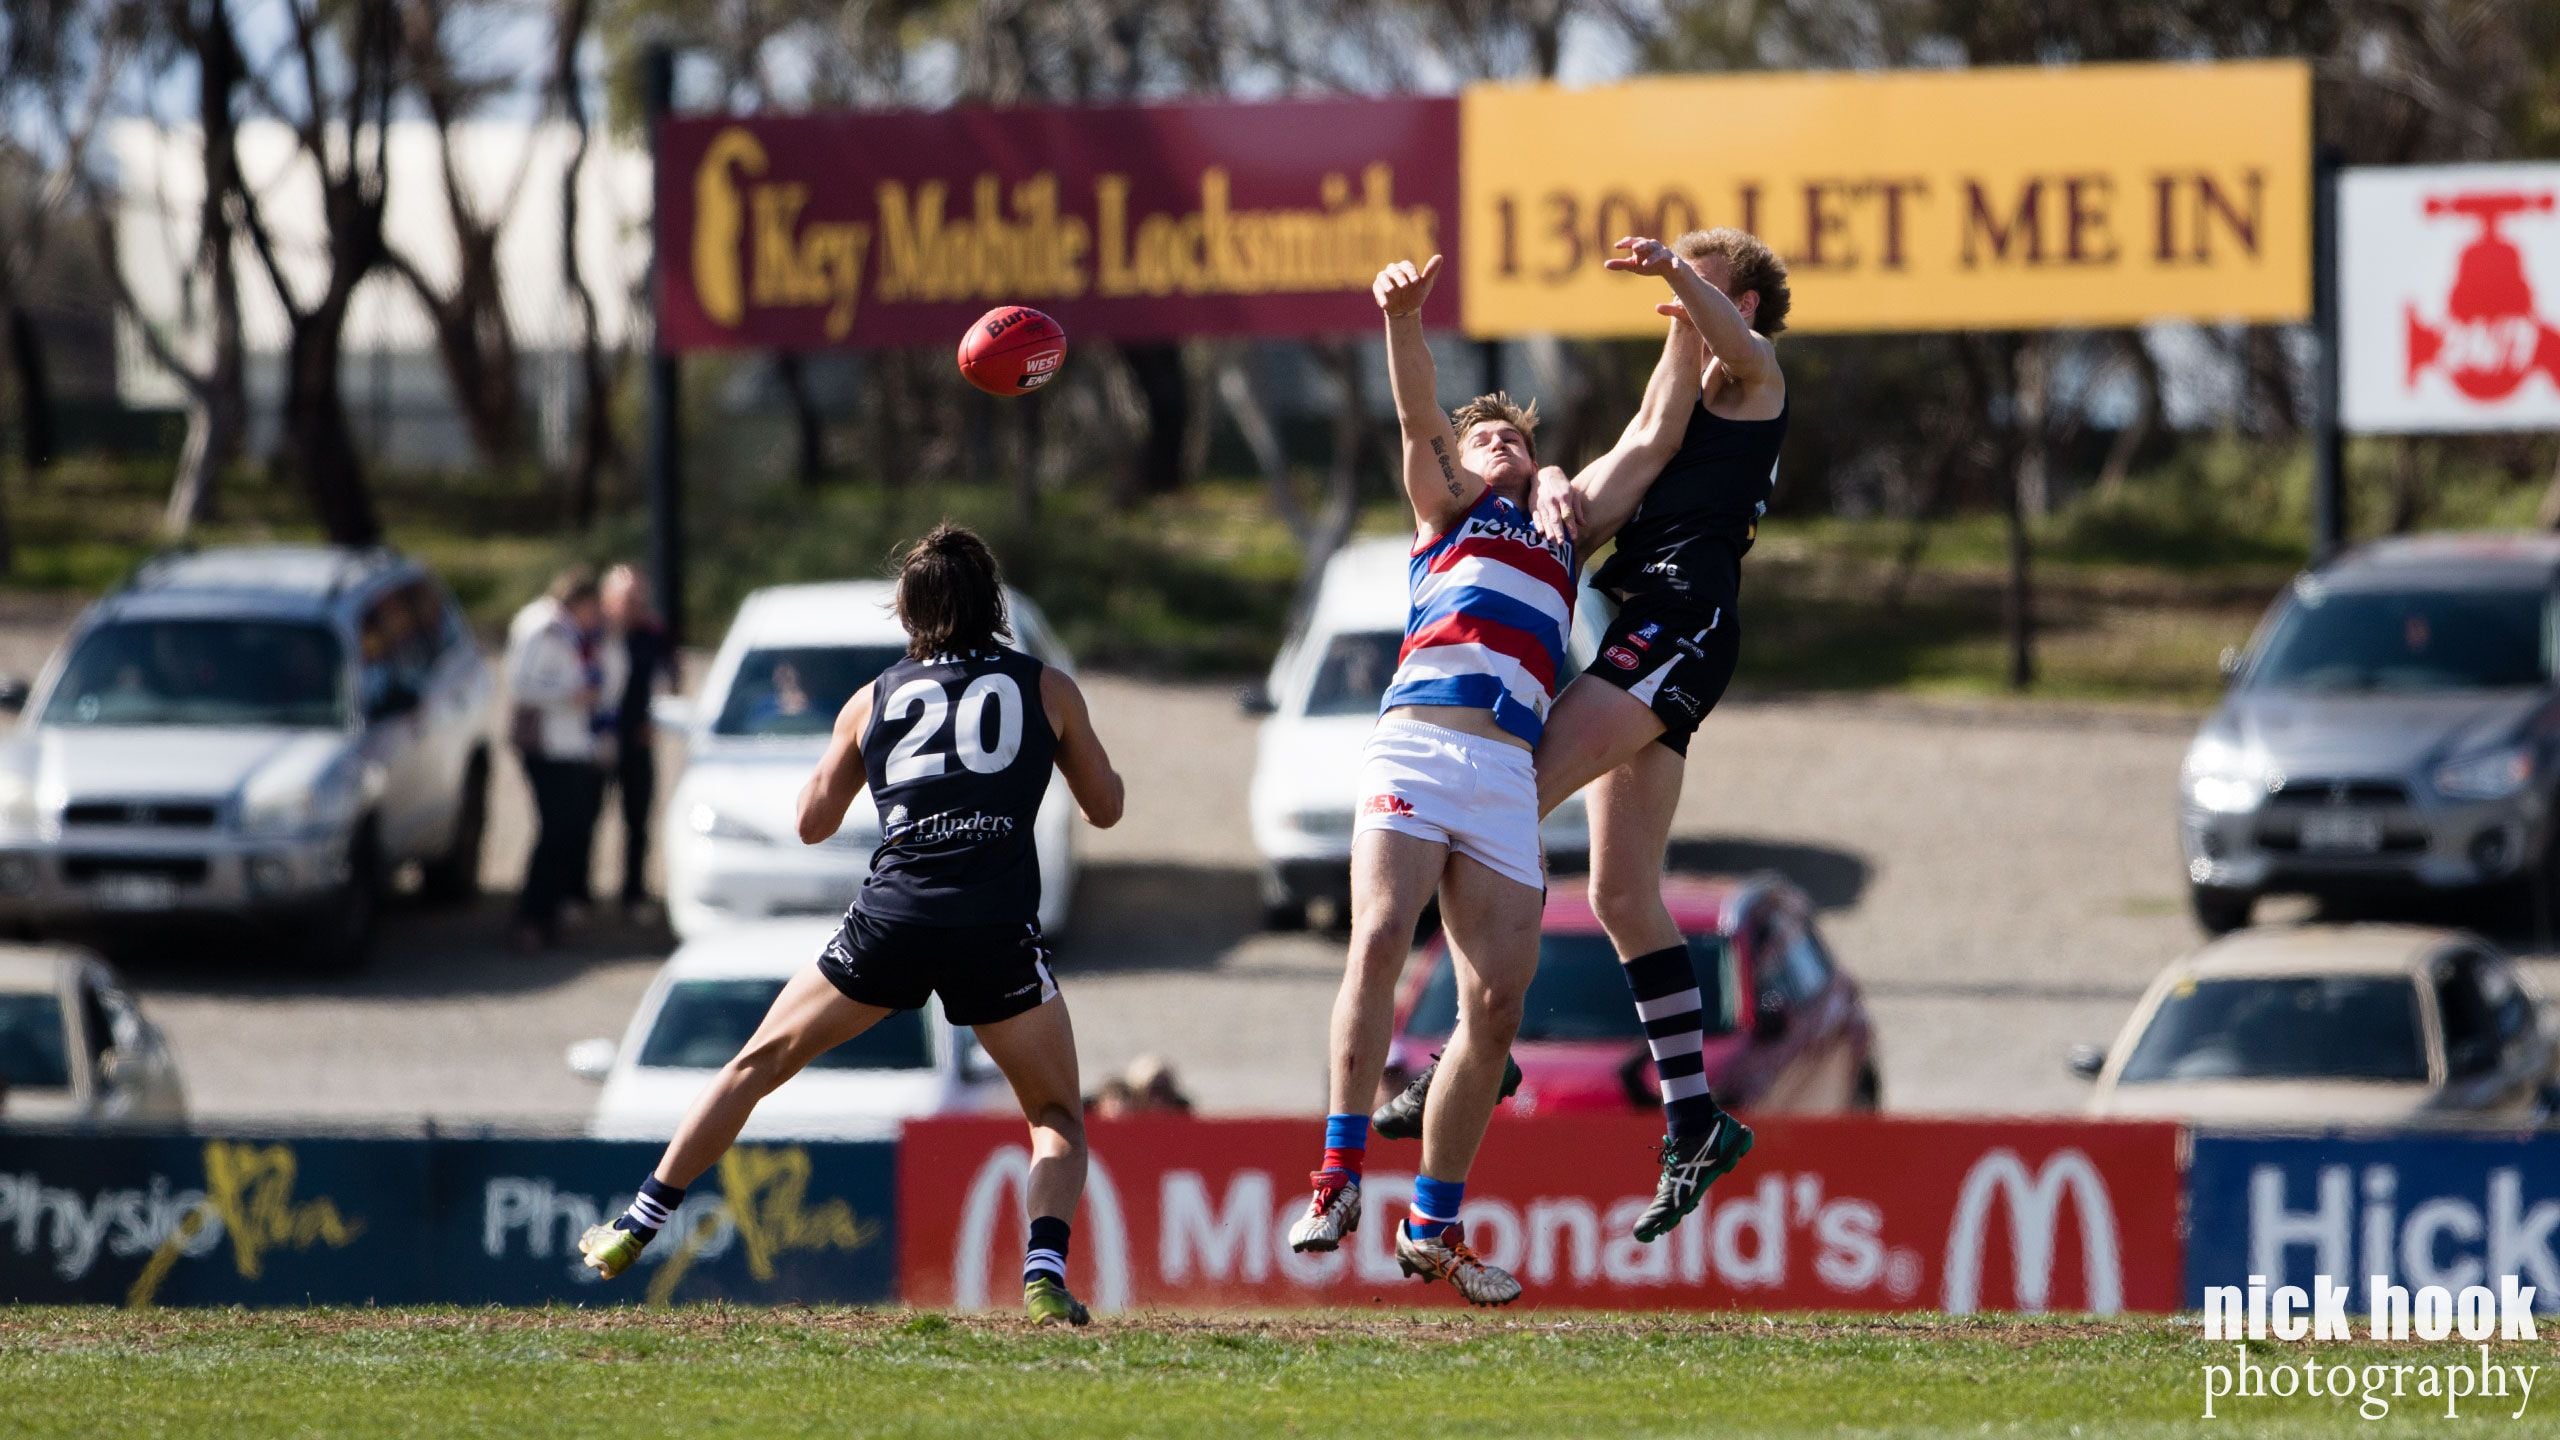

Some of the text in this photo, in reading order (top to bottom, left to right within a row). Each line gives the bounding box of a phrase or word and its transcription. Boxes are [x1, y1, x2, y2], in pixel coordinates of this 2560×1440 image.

[1963, 167, 2120, 269] ME
[2150, 166, 2266, 266] IN
[748, 181, 872, 341] Key
[875, 168, 1092, 304] Mobile
[1024, 372, 1054, 387] END
[1026, 353, 1061, 372] WEST
[883, 672, 1025, 786] 20
[915, 810, 1014, 834] Flinders
